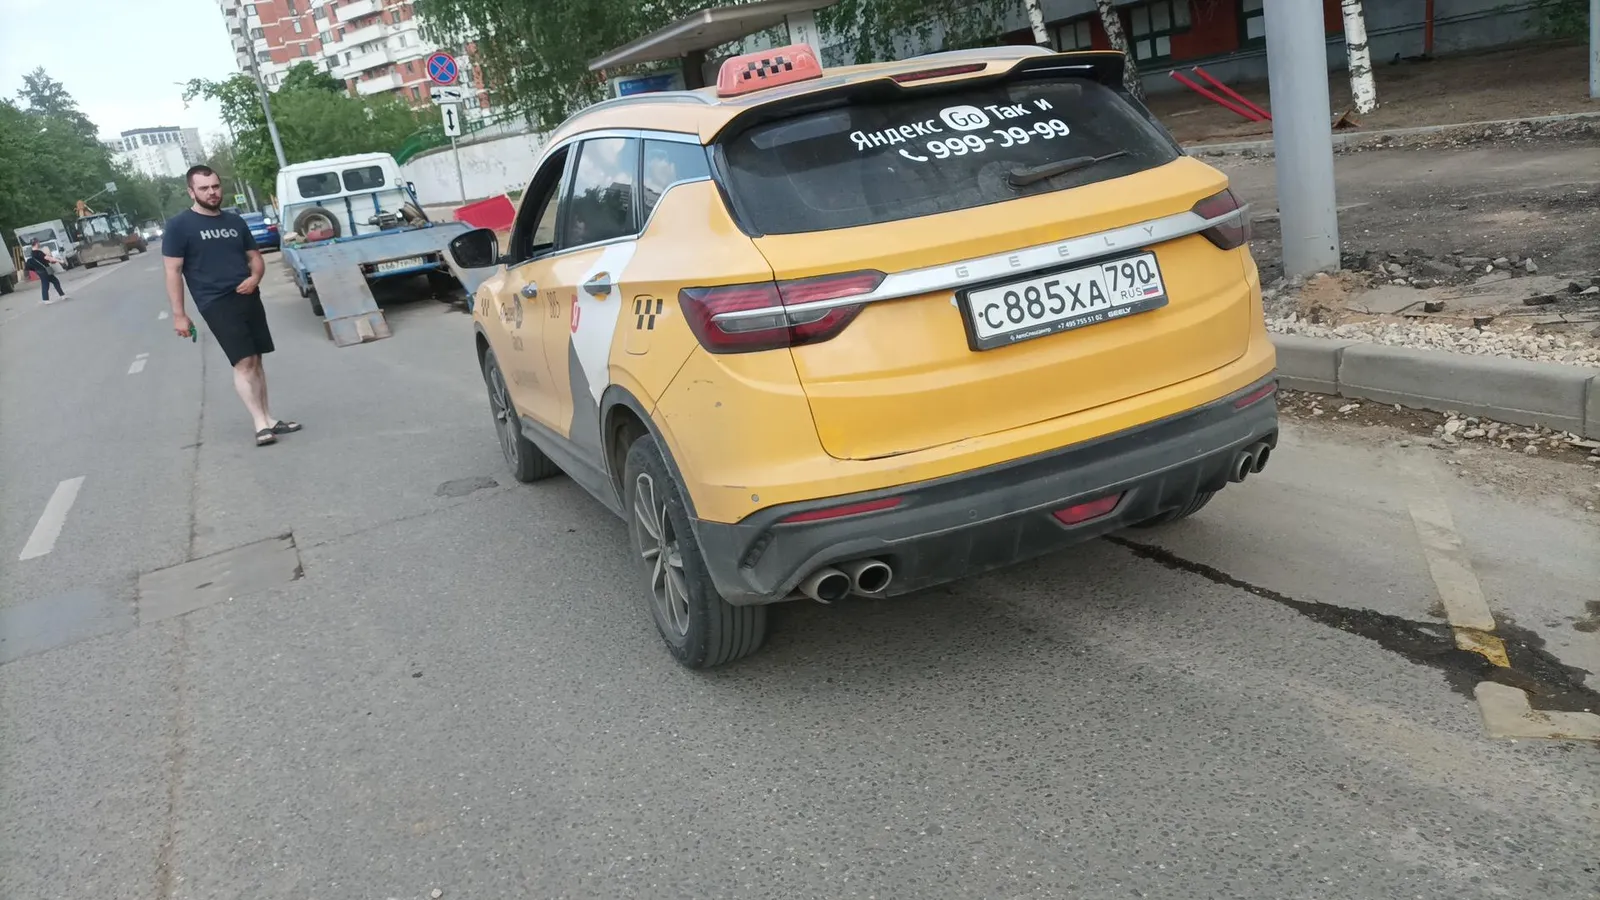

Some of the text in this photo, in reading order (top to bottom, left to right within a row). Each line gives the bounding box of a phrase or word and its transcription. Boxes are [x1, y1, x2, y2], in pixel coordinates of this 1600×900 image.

[850, 98, 1053, 150] Яндекс Go Так и
[200, 228, 239, 240] HUGO
[955, 226, 1154, 278] GEELY
[1105, 259, 1150, 292] 790
[1120, 287, 1143, 300] RUS
[1107, 306, 1131, 318] GEELY
[1065, 319, 1076, 328] 495
[1076, 317, 1088, 326] 755
